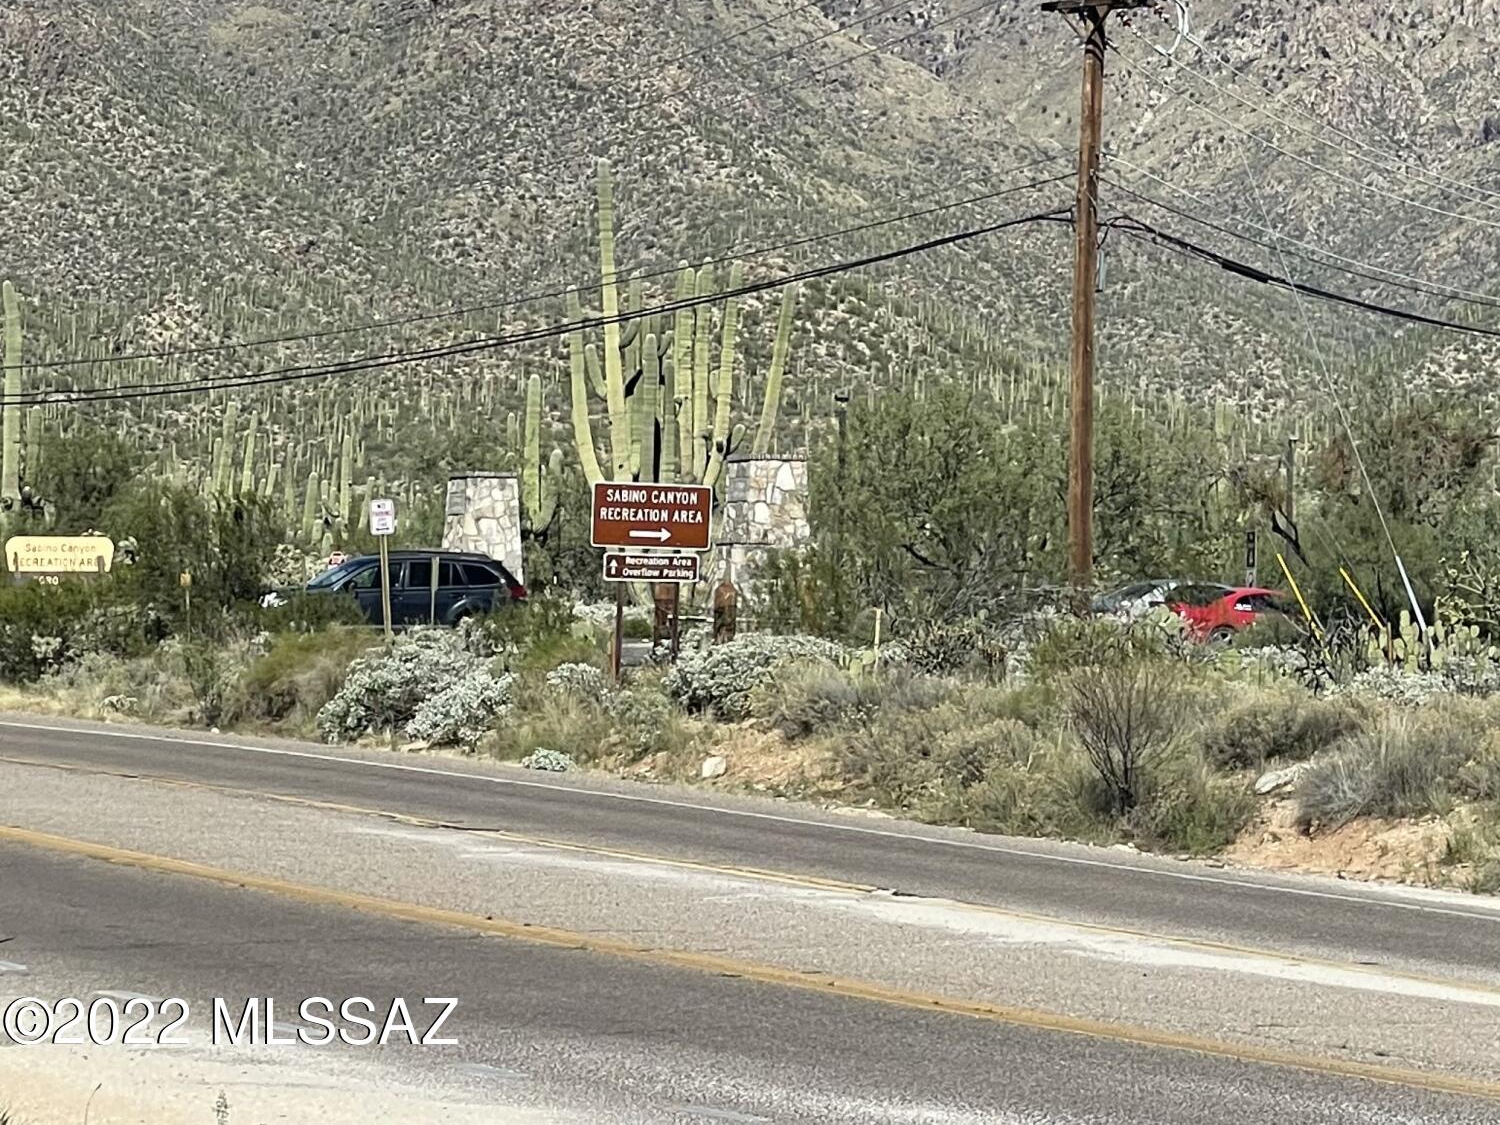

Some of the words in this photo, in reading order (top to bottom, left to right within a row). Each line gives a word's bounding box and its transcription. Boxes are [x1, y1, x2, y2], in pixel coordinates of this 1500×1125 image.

[606, 489, 647, 503] SABINO
[651, 492, 698, 505] CANYON
[600, 507, 668, 522] RECREATION
[672, 510, 703, 523] AREA
[60, 544, 96, 554] Canyon
[13, 557, 76, 567] ECREATION
[625, 557, 669, 566] Recreation
[672, 557, 692, 567] Area
[622, 568, 660, 577] Overflow
[663, 569, 694, 580] Parking
